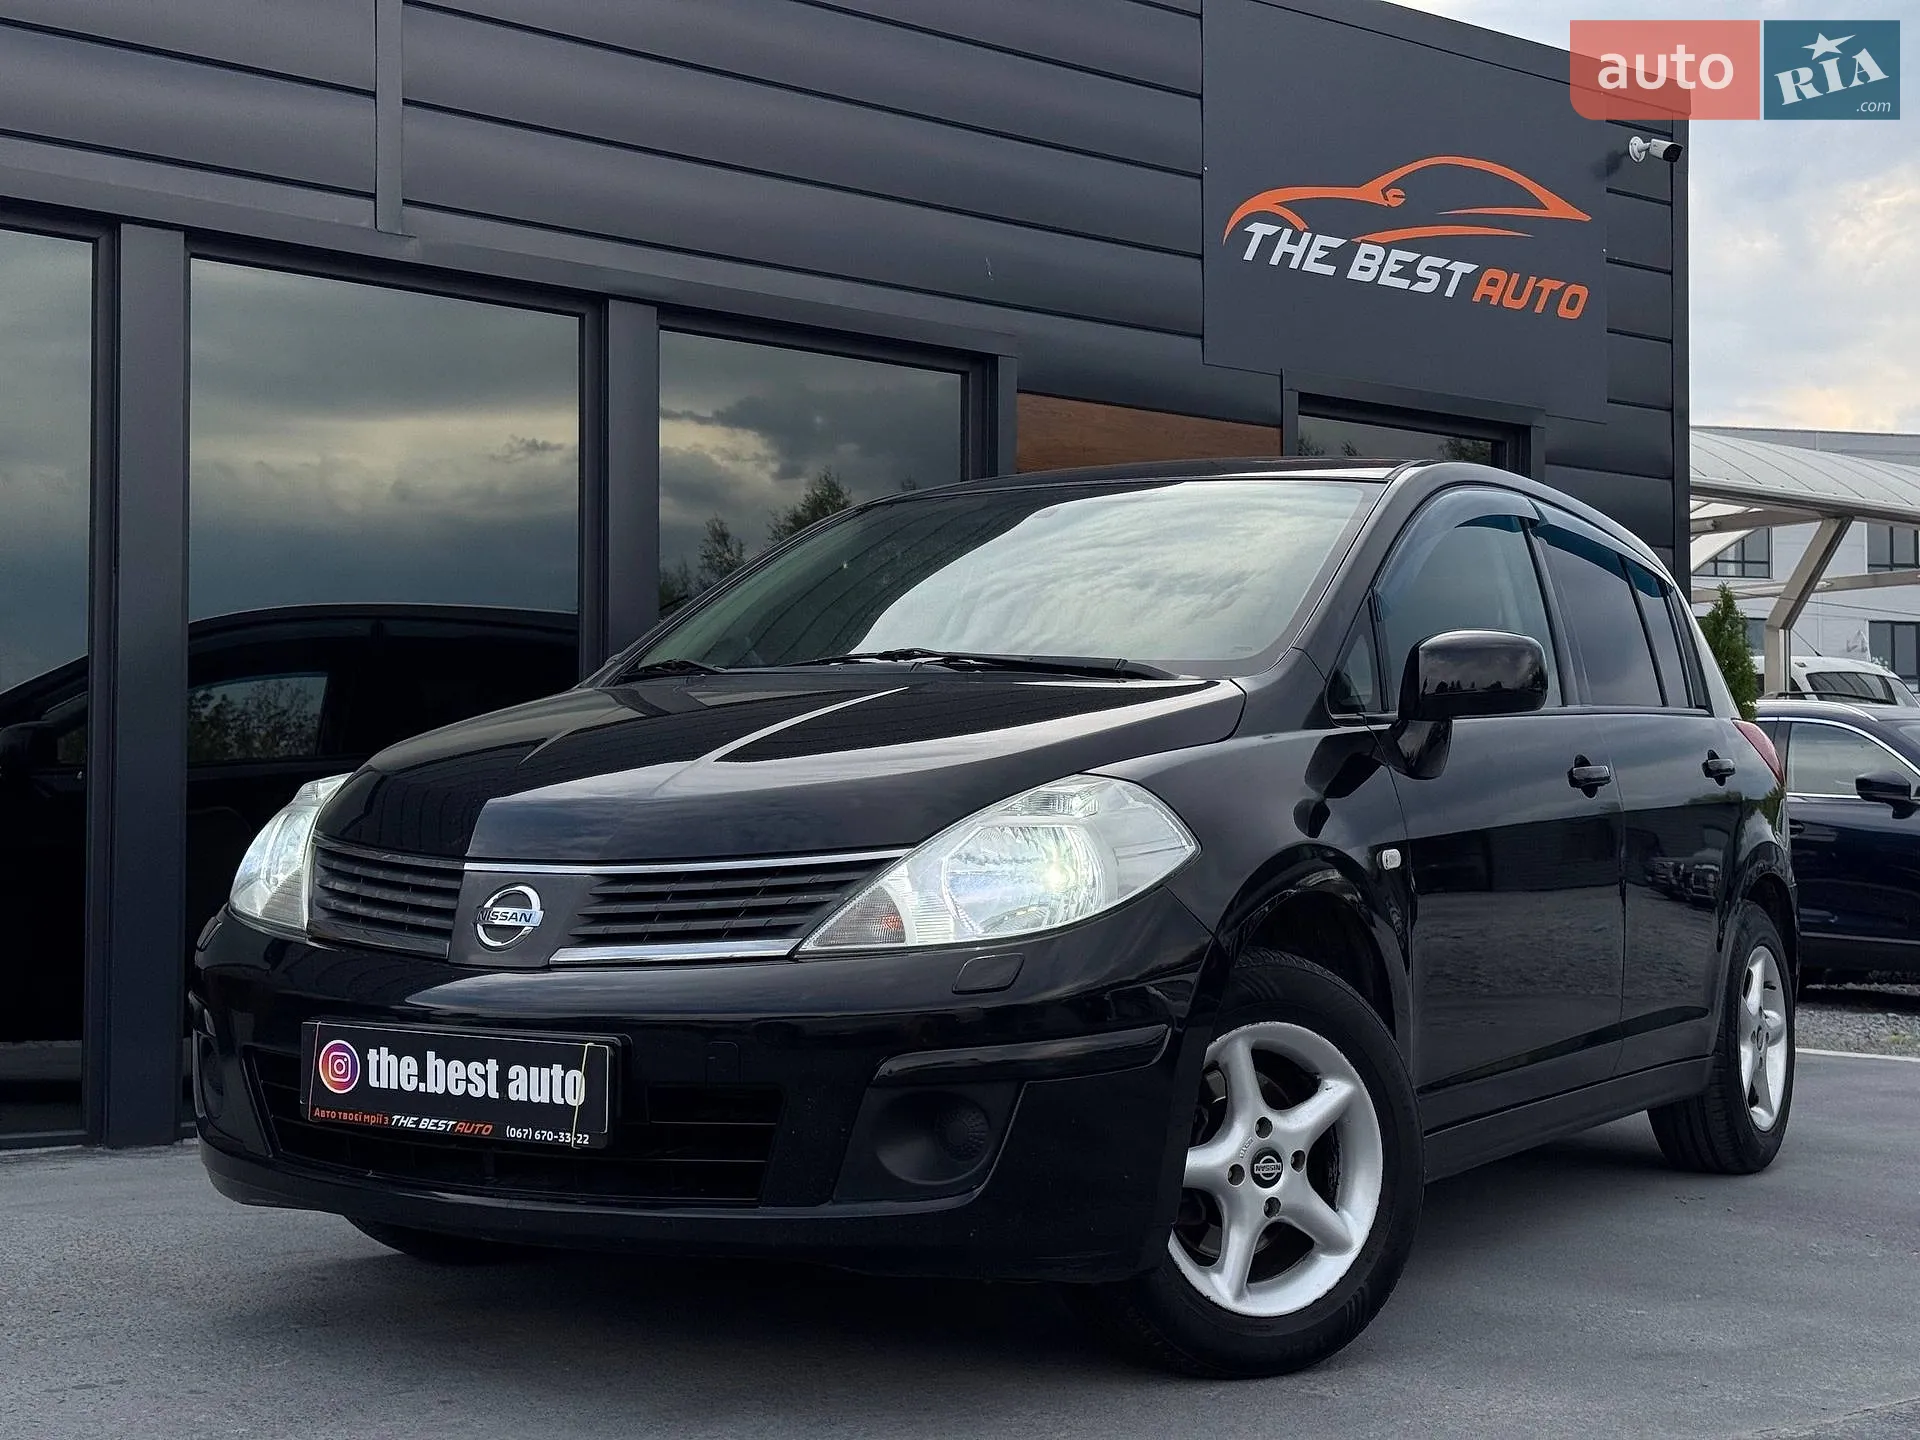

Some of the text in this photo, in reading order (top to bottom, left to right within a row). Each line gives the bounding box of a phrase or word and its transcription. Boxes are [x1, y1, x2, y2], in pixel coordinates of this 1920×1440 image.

[1243, 222, 1589, 320] THE BEST AUTO
[478, 910, 533, 923] NISSAN
[367, 1047, 585, 1107] the.best auto
[314, 1107, 336, 1119] Авто
[391, 1115, 419, 1128] THE
[418, 1118, 457, 1132] BEST
[455, 1122, 493, 1136] AUTO
[506, 1125, 532, 1140] (067)
